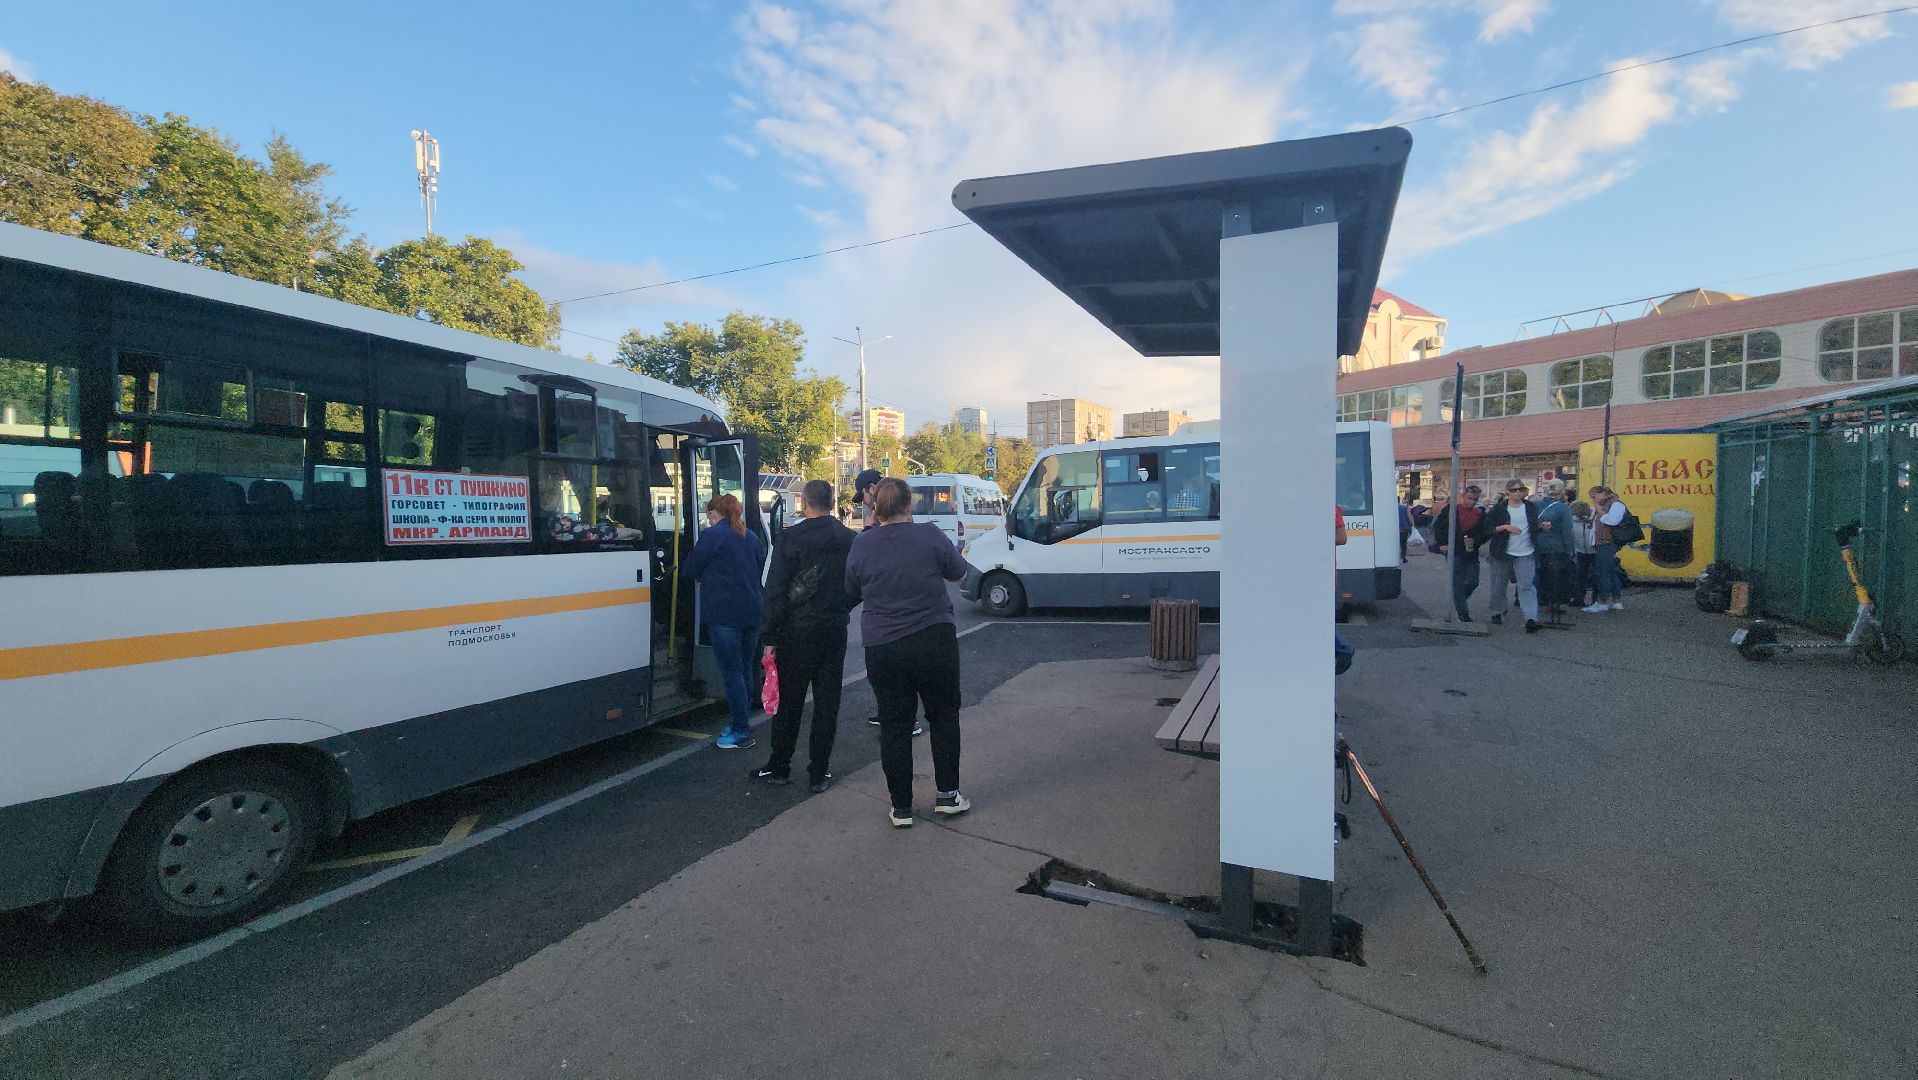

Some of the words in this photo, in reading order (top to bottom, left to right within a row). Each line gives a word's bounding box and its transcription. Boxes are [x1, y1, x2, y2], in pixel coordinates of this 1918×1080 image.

[1625, 458, 1715, 480] КВАС
[434, 478, 458, 496] СТ.
[460, 479, 526, 497] ПУШКИНО
[391, 499, 446, 510] ГОРСОВЕТ
[462, 501, 526, 511] ТИПОГРАФИЯ
[392, 514, 430, 525] ШКОЛА
[437, 514, 464, 525] Ф-КА
[465, 515, 488, 525] СЕРП
[489, 515, 495, 524] И
[496, 514, 527, 525] МОЛОТ
[392, 527, 445, 539] МКР.
[448, 526, 527, 538] АРМАНД
[1118, 546, 1211, 555] МОСТРАНСАВТО
[448, 624, 502, 637] ТРАНСПОРТ
[448, 632, 516, 647] ПОДМОСКОВЬЯ
